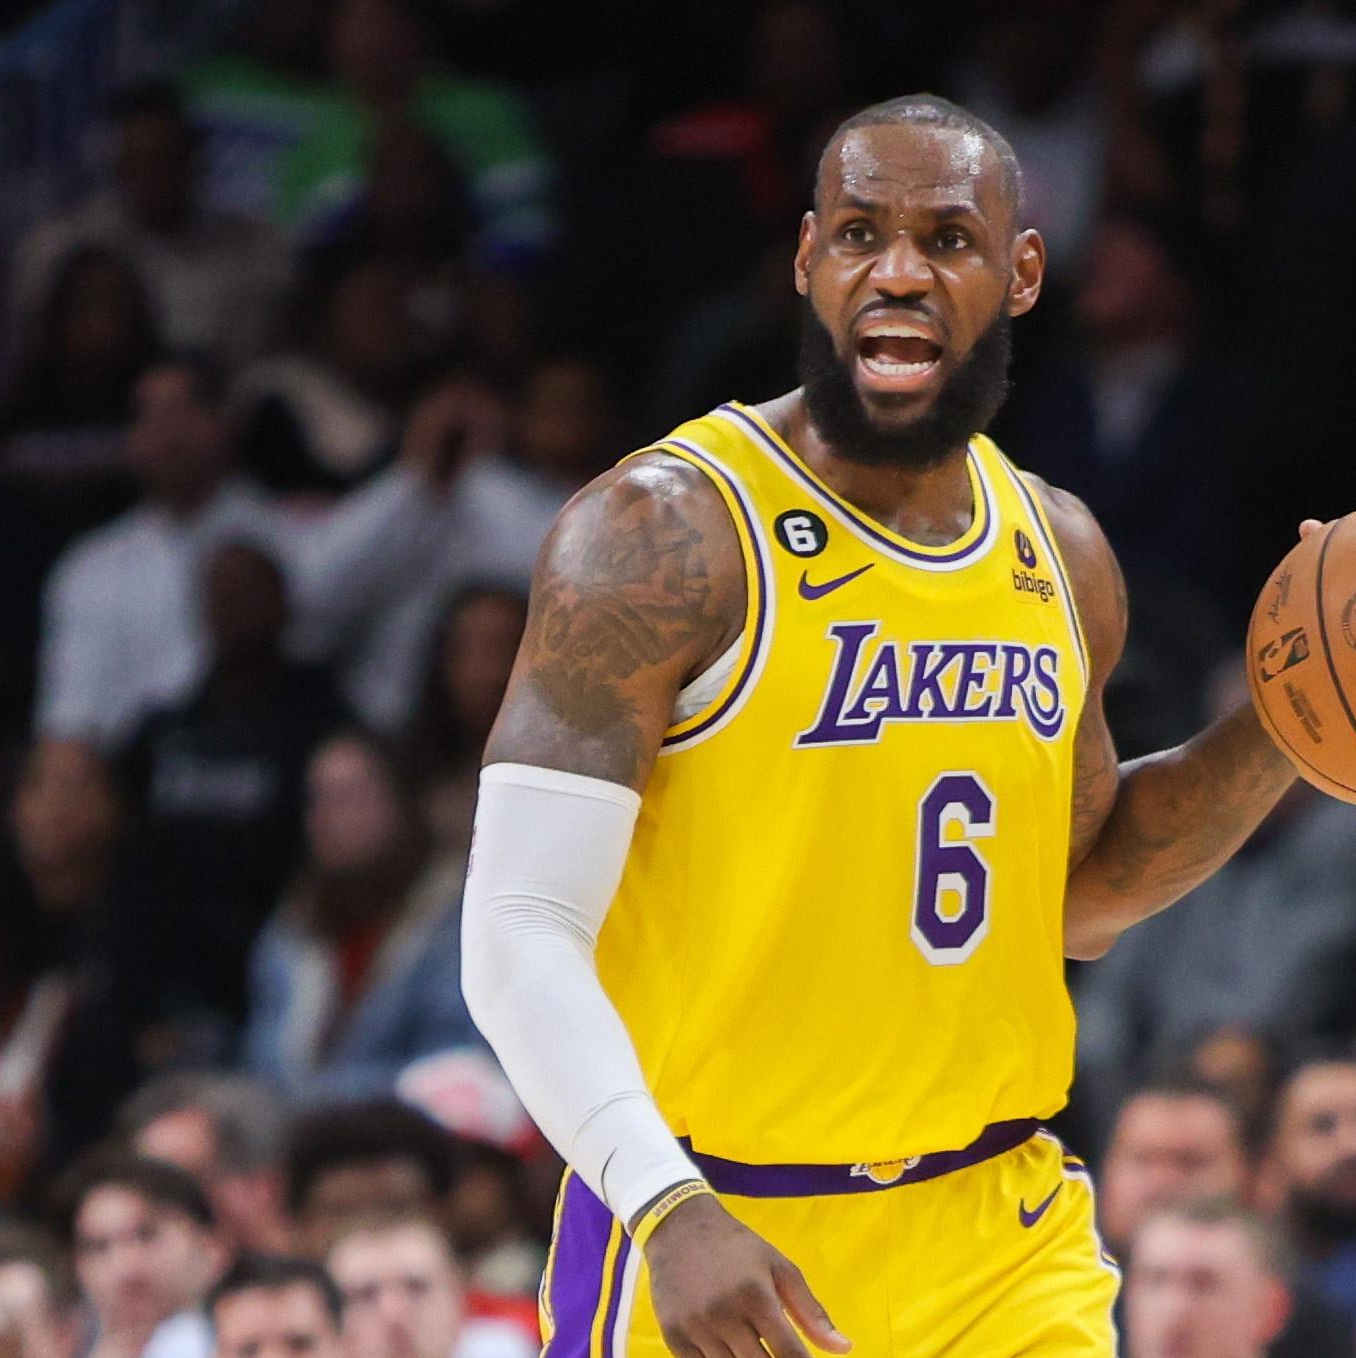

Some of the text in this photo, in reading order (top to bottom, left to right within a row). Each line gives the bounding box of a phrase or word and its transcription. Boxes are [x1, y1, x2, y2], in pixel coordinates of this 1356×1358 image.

[783, 516, 818, 552] 6
[1011, 569, 1055, 603] bibigo
[791, 620, 1067, 749] LAKERS
[910, 770, 997, 966] 6
